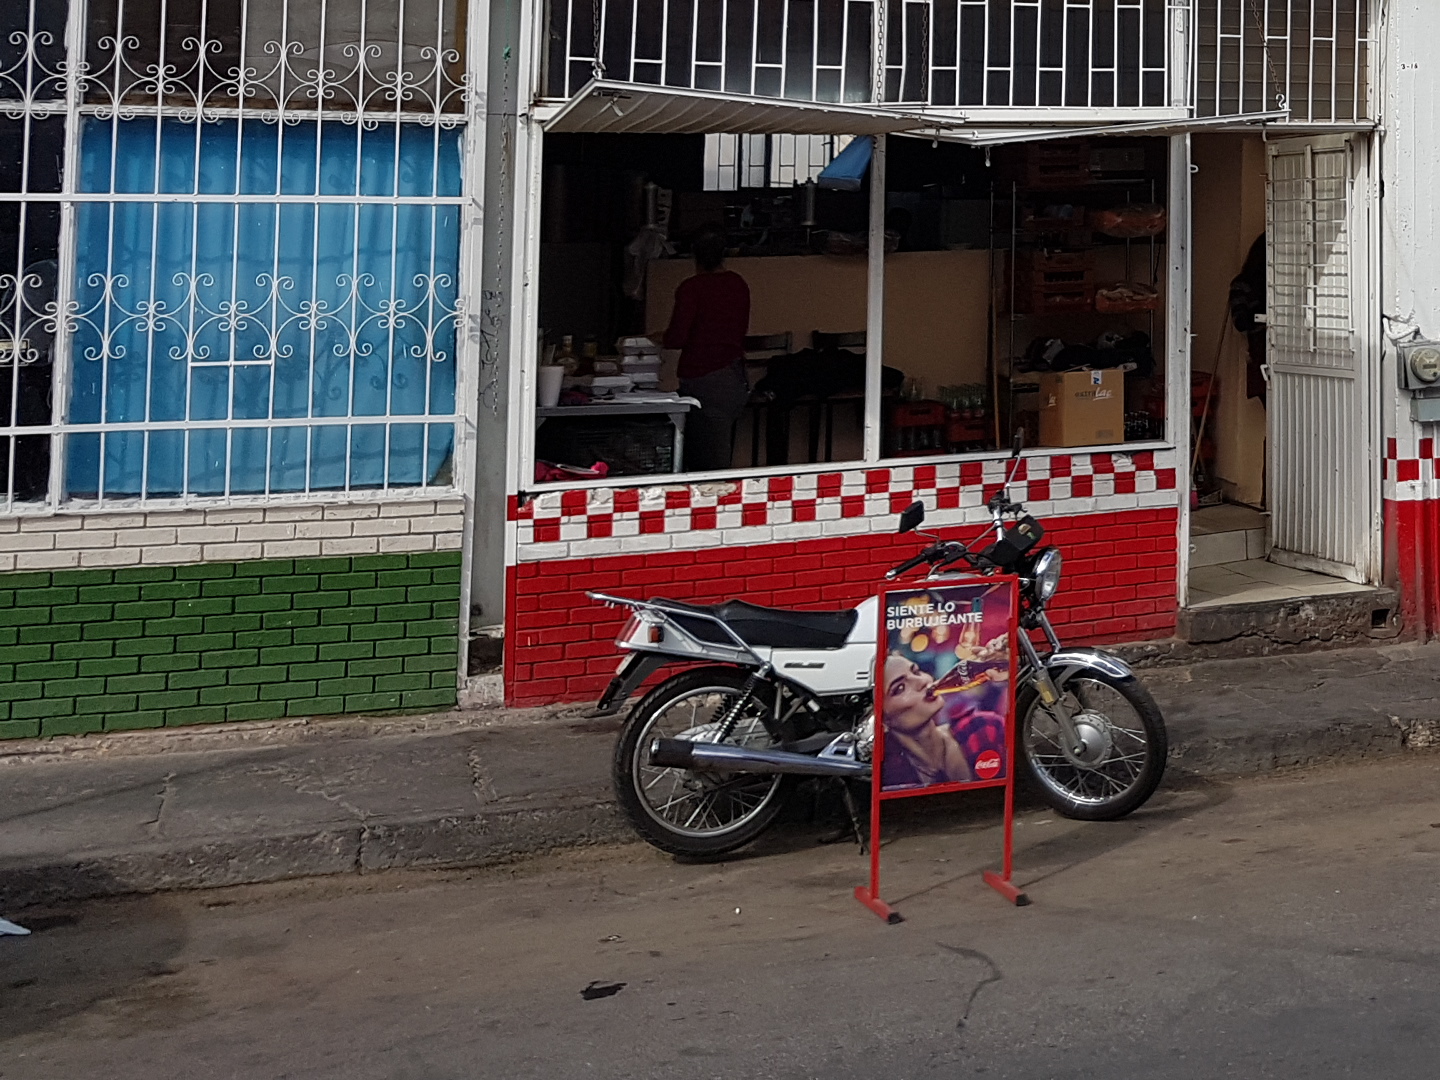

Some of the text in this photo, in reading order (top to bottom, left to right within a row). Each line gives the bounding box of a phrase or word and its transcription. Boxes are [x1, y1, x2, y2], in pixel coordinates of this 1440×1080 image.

[886, 601, 956, 618] SIENTE LO
[886, 611, 983, 630] BURBUJEANTE
